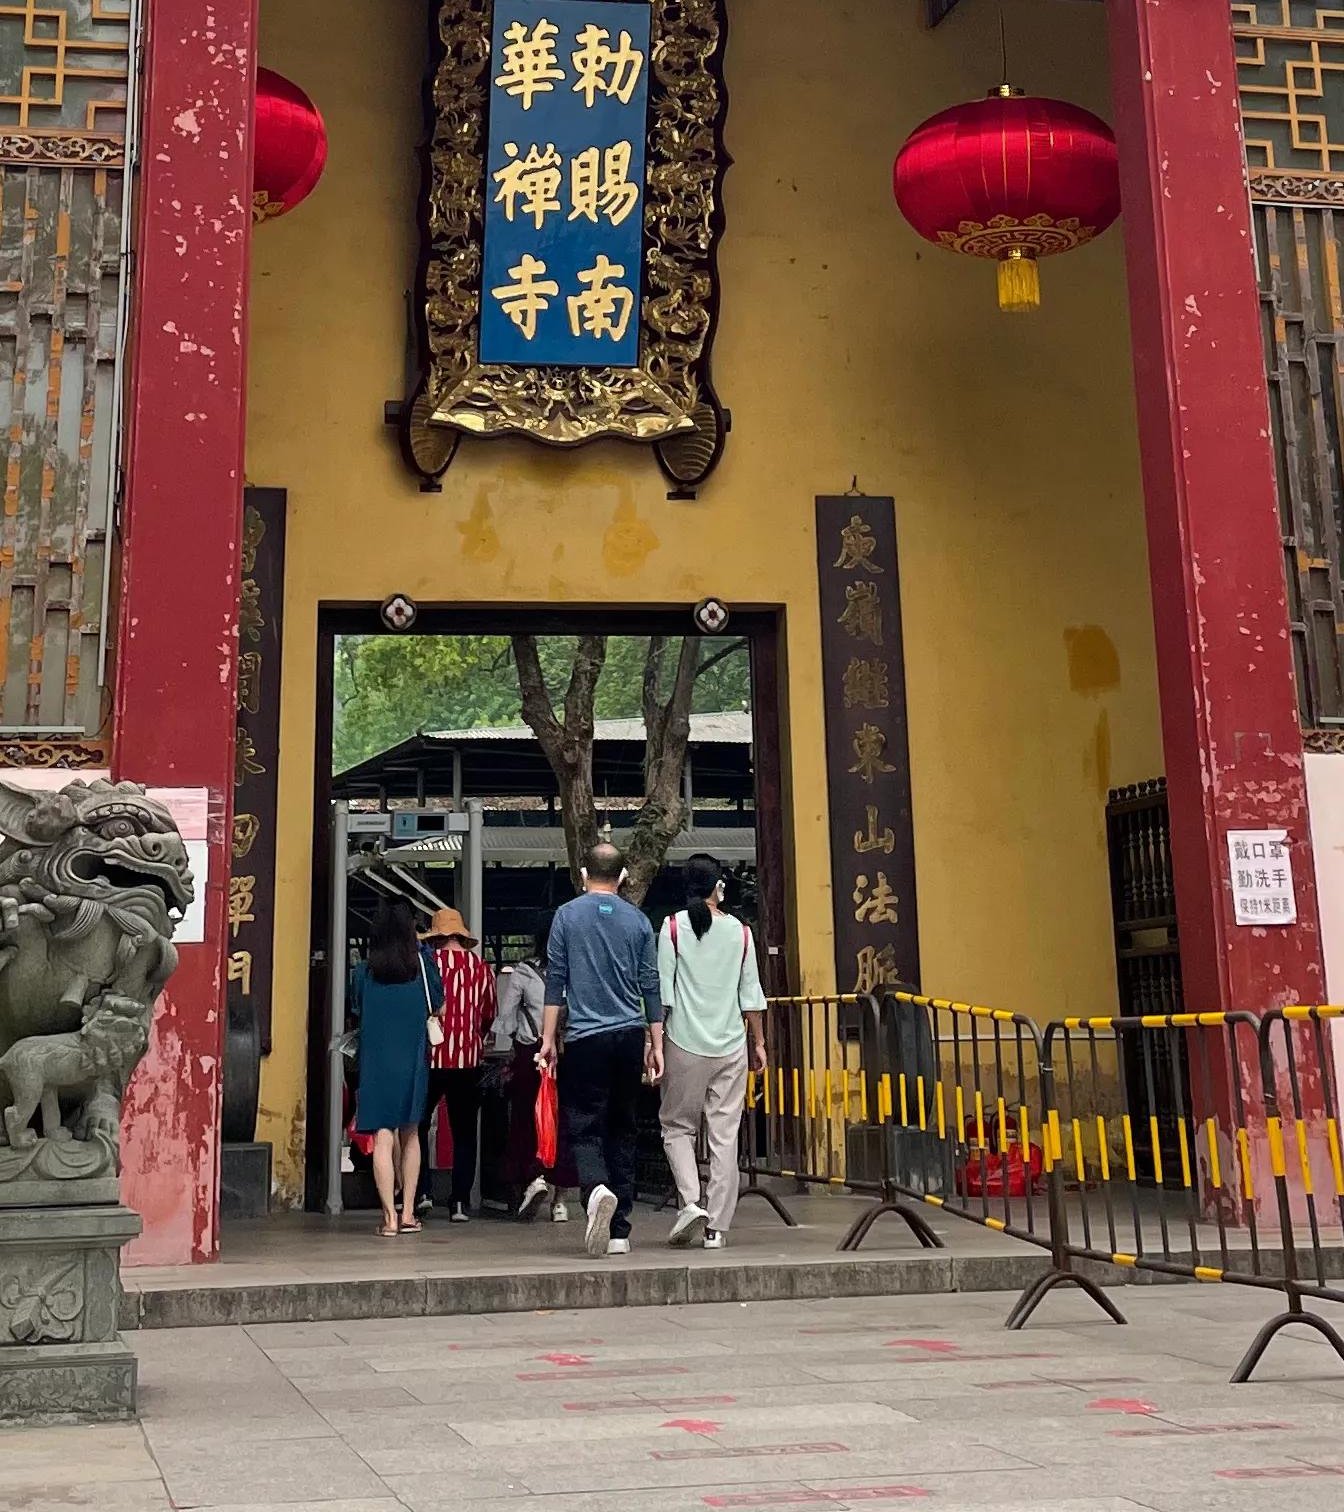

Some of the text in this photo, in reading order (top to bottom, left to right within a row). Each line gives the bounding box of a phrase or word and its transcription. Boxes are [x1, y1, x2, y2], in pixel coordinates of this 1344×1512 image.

[1234, 840, 1285, 860] 戴口罩
[1237, 869, 1287, 888] 勤洗手
